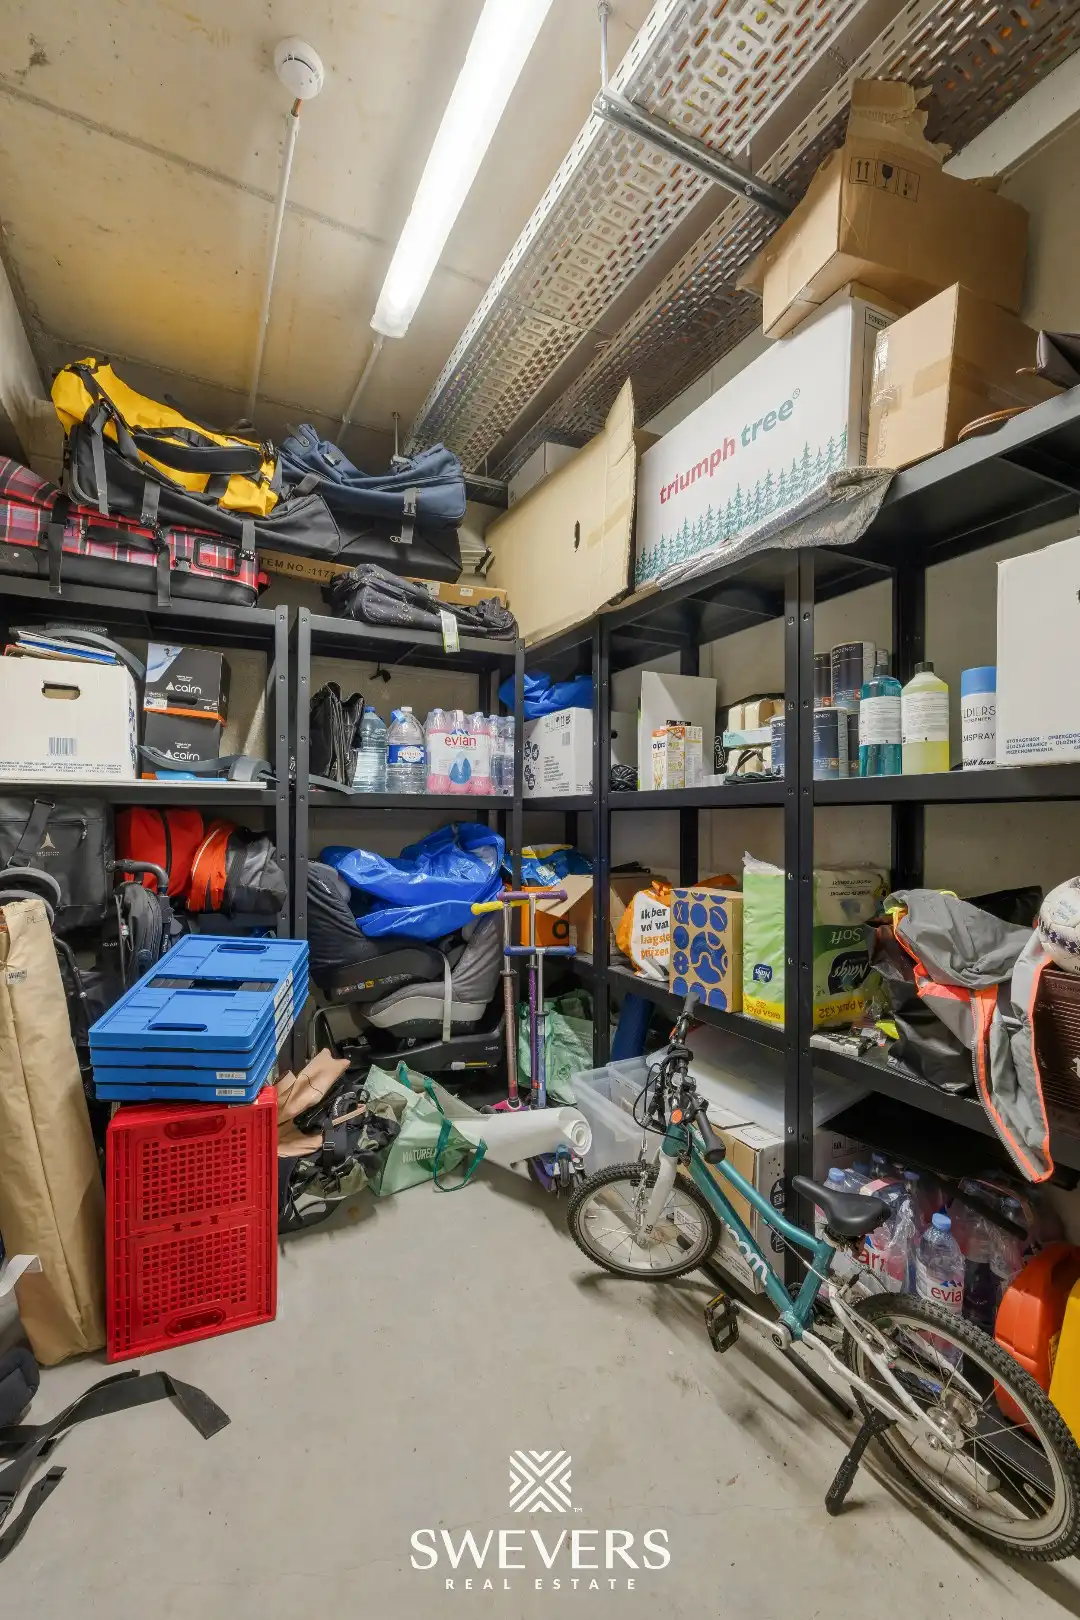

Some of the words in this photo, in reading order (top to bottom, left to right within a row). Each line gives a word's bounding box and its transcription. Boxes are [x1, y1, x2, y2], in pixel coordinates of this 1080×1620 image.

[659, 437, 735, 504] triumph
[260, 557, 284, 568] TEM
[174, 684, 202, 694] cairn
[444, 735, 477, 746] evian
[173, 751, 200, 760] cairn
[641, 908, 650, 919] Ik
[829, 927, 862, 945] Soft
[930, 1287, 962, 1303] evia
